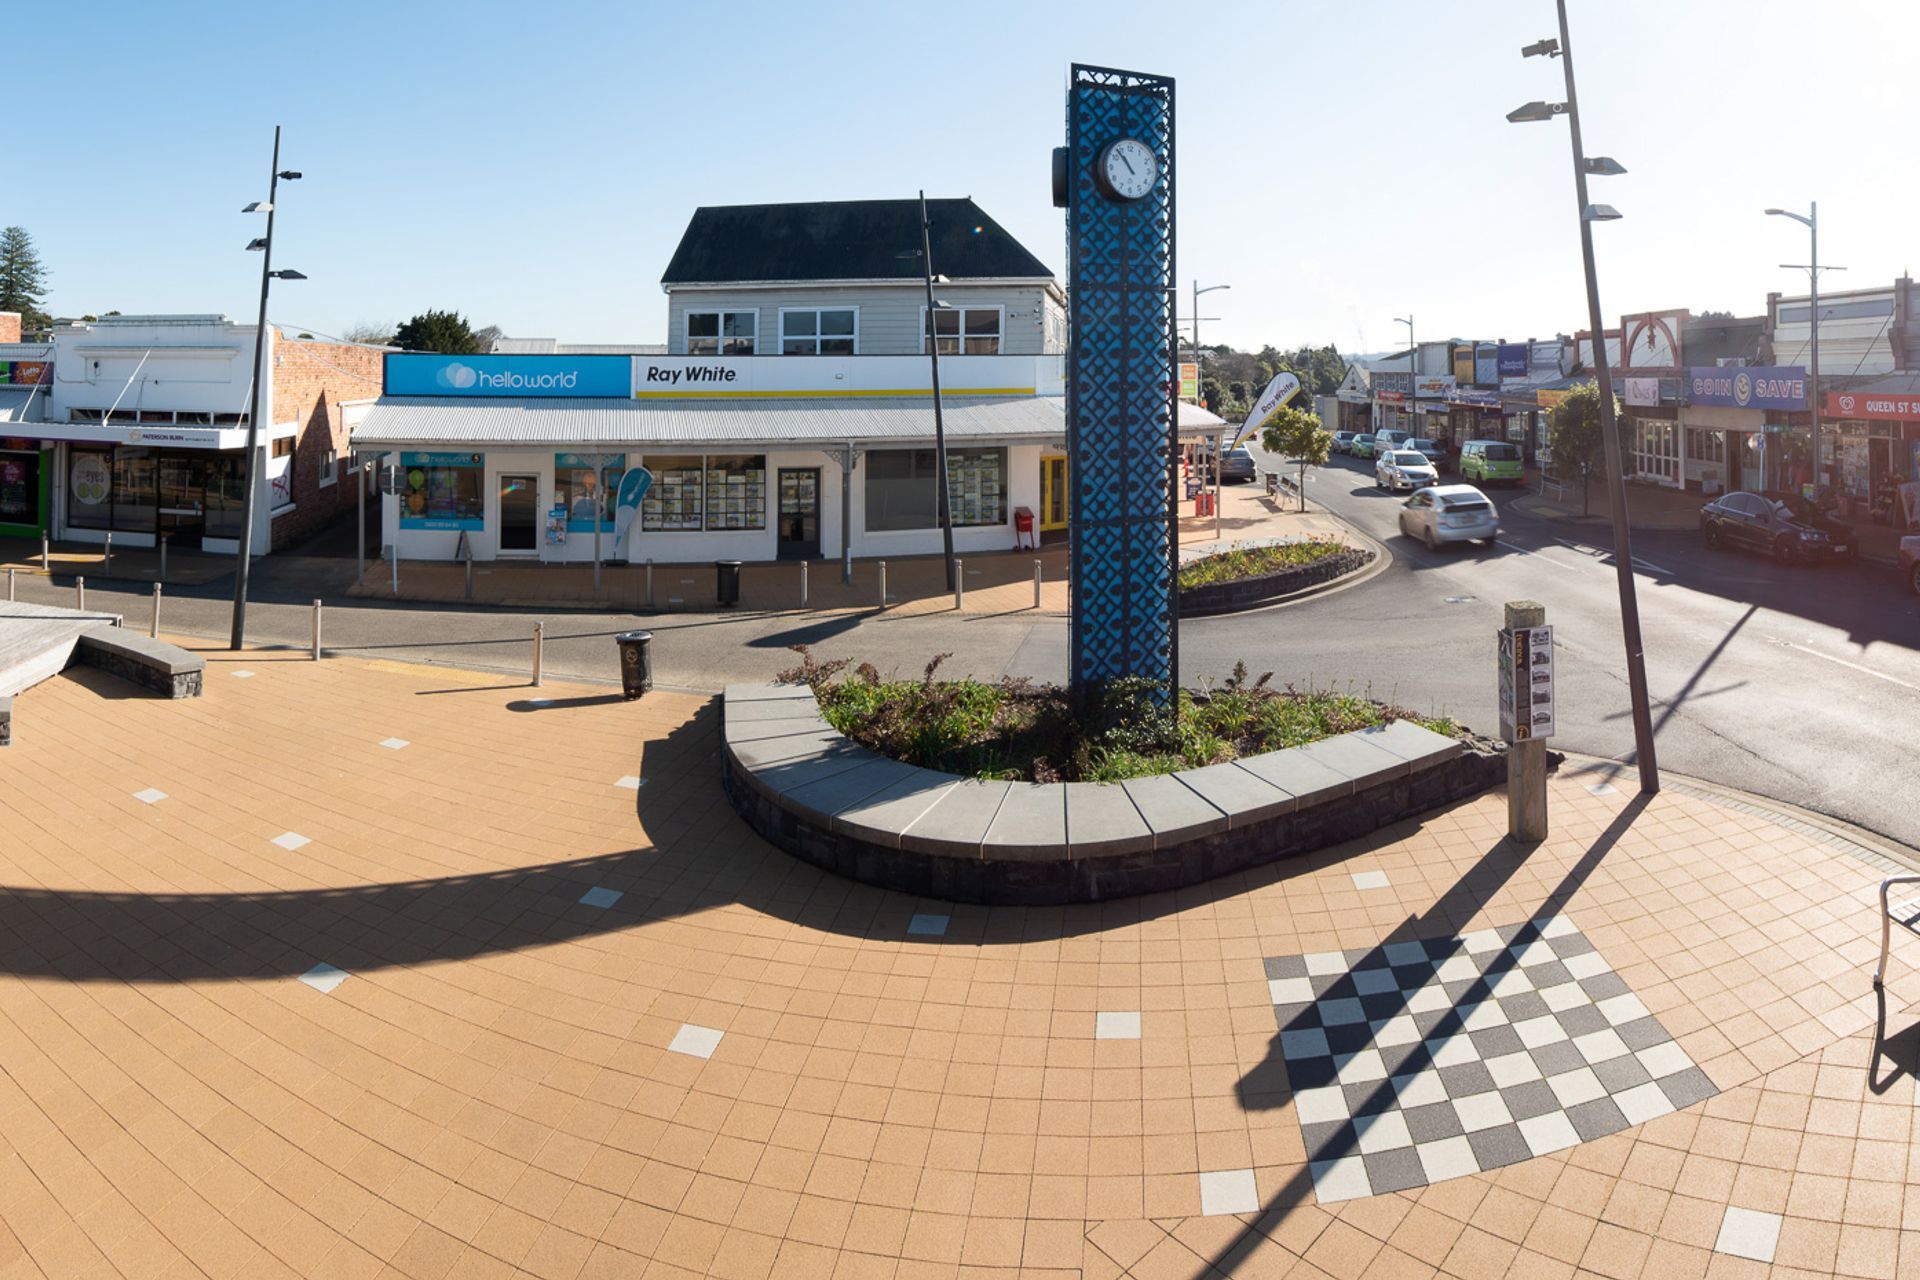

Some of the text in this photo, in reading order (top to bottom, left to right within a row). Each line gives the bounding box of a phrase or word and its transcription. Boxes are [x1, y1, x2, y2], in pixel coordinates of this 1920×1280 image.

[1112, 153, 1120, 161] 10
[1143, 157, 1149, 165] 2
[1146, 167, 1152, 175] 3
[1119, 182, 1124, 190] 7
[1127, 186, 1132, 194] 6
[1137, 184, 1142, 192] 5
[647, 365, 736, 385] Ray White
[479, 370, 578, 389] helloworld
[1693, 378, 1804, 399] COIN SAVE
[1261, 382, 1295, 414] Ray White
[1866, 400, 1895, 413] QUEEN
[1897, 401, 1909, 413] ST
[142, 433, 168, 441] PATERSON
[86, 471, 104, 484] eyes
